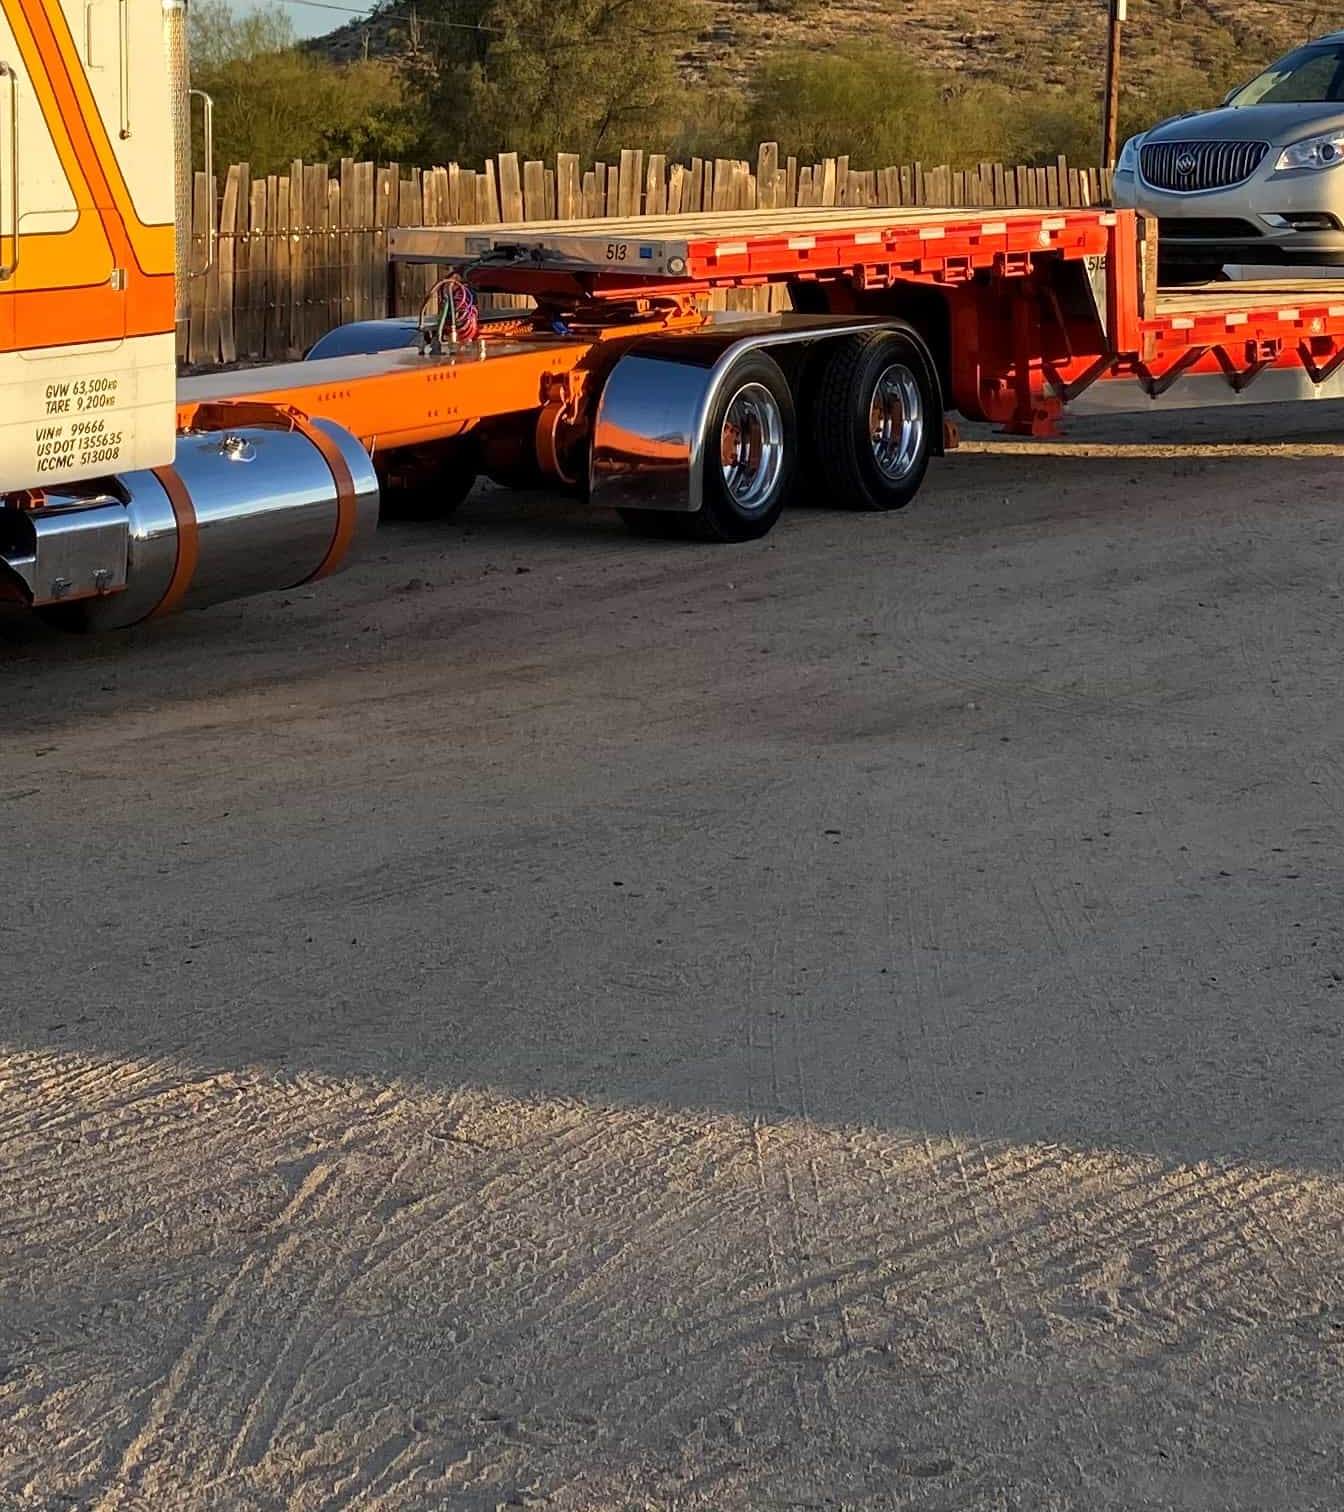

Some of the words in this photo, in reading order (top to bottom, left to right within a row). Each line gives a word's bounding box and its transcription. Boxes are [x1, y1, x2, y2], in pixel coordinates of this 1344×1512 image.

[606, 243, 627, 260] 513
[45, 384, 70, 399] GVW
[45, 399, 71, 414] TARE
[71, 419, 104, 436] 99666
[78, 432, 122, 449] 1355635
[37, 454, 74, 472] ICCMC
[81, 447, 119, 465] 513008
